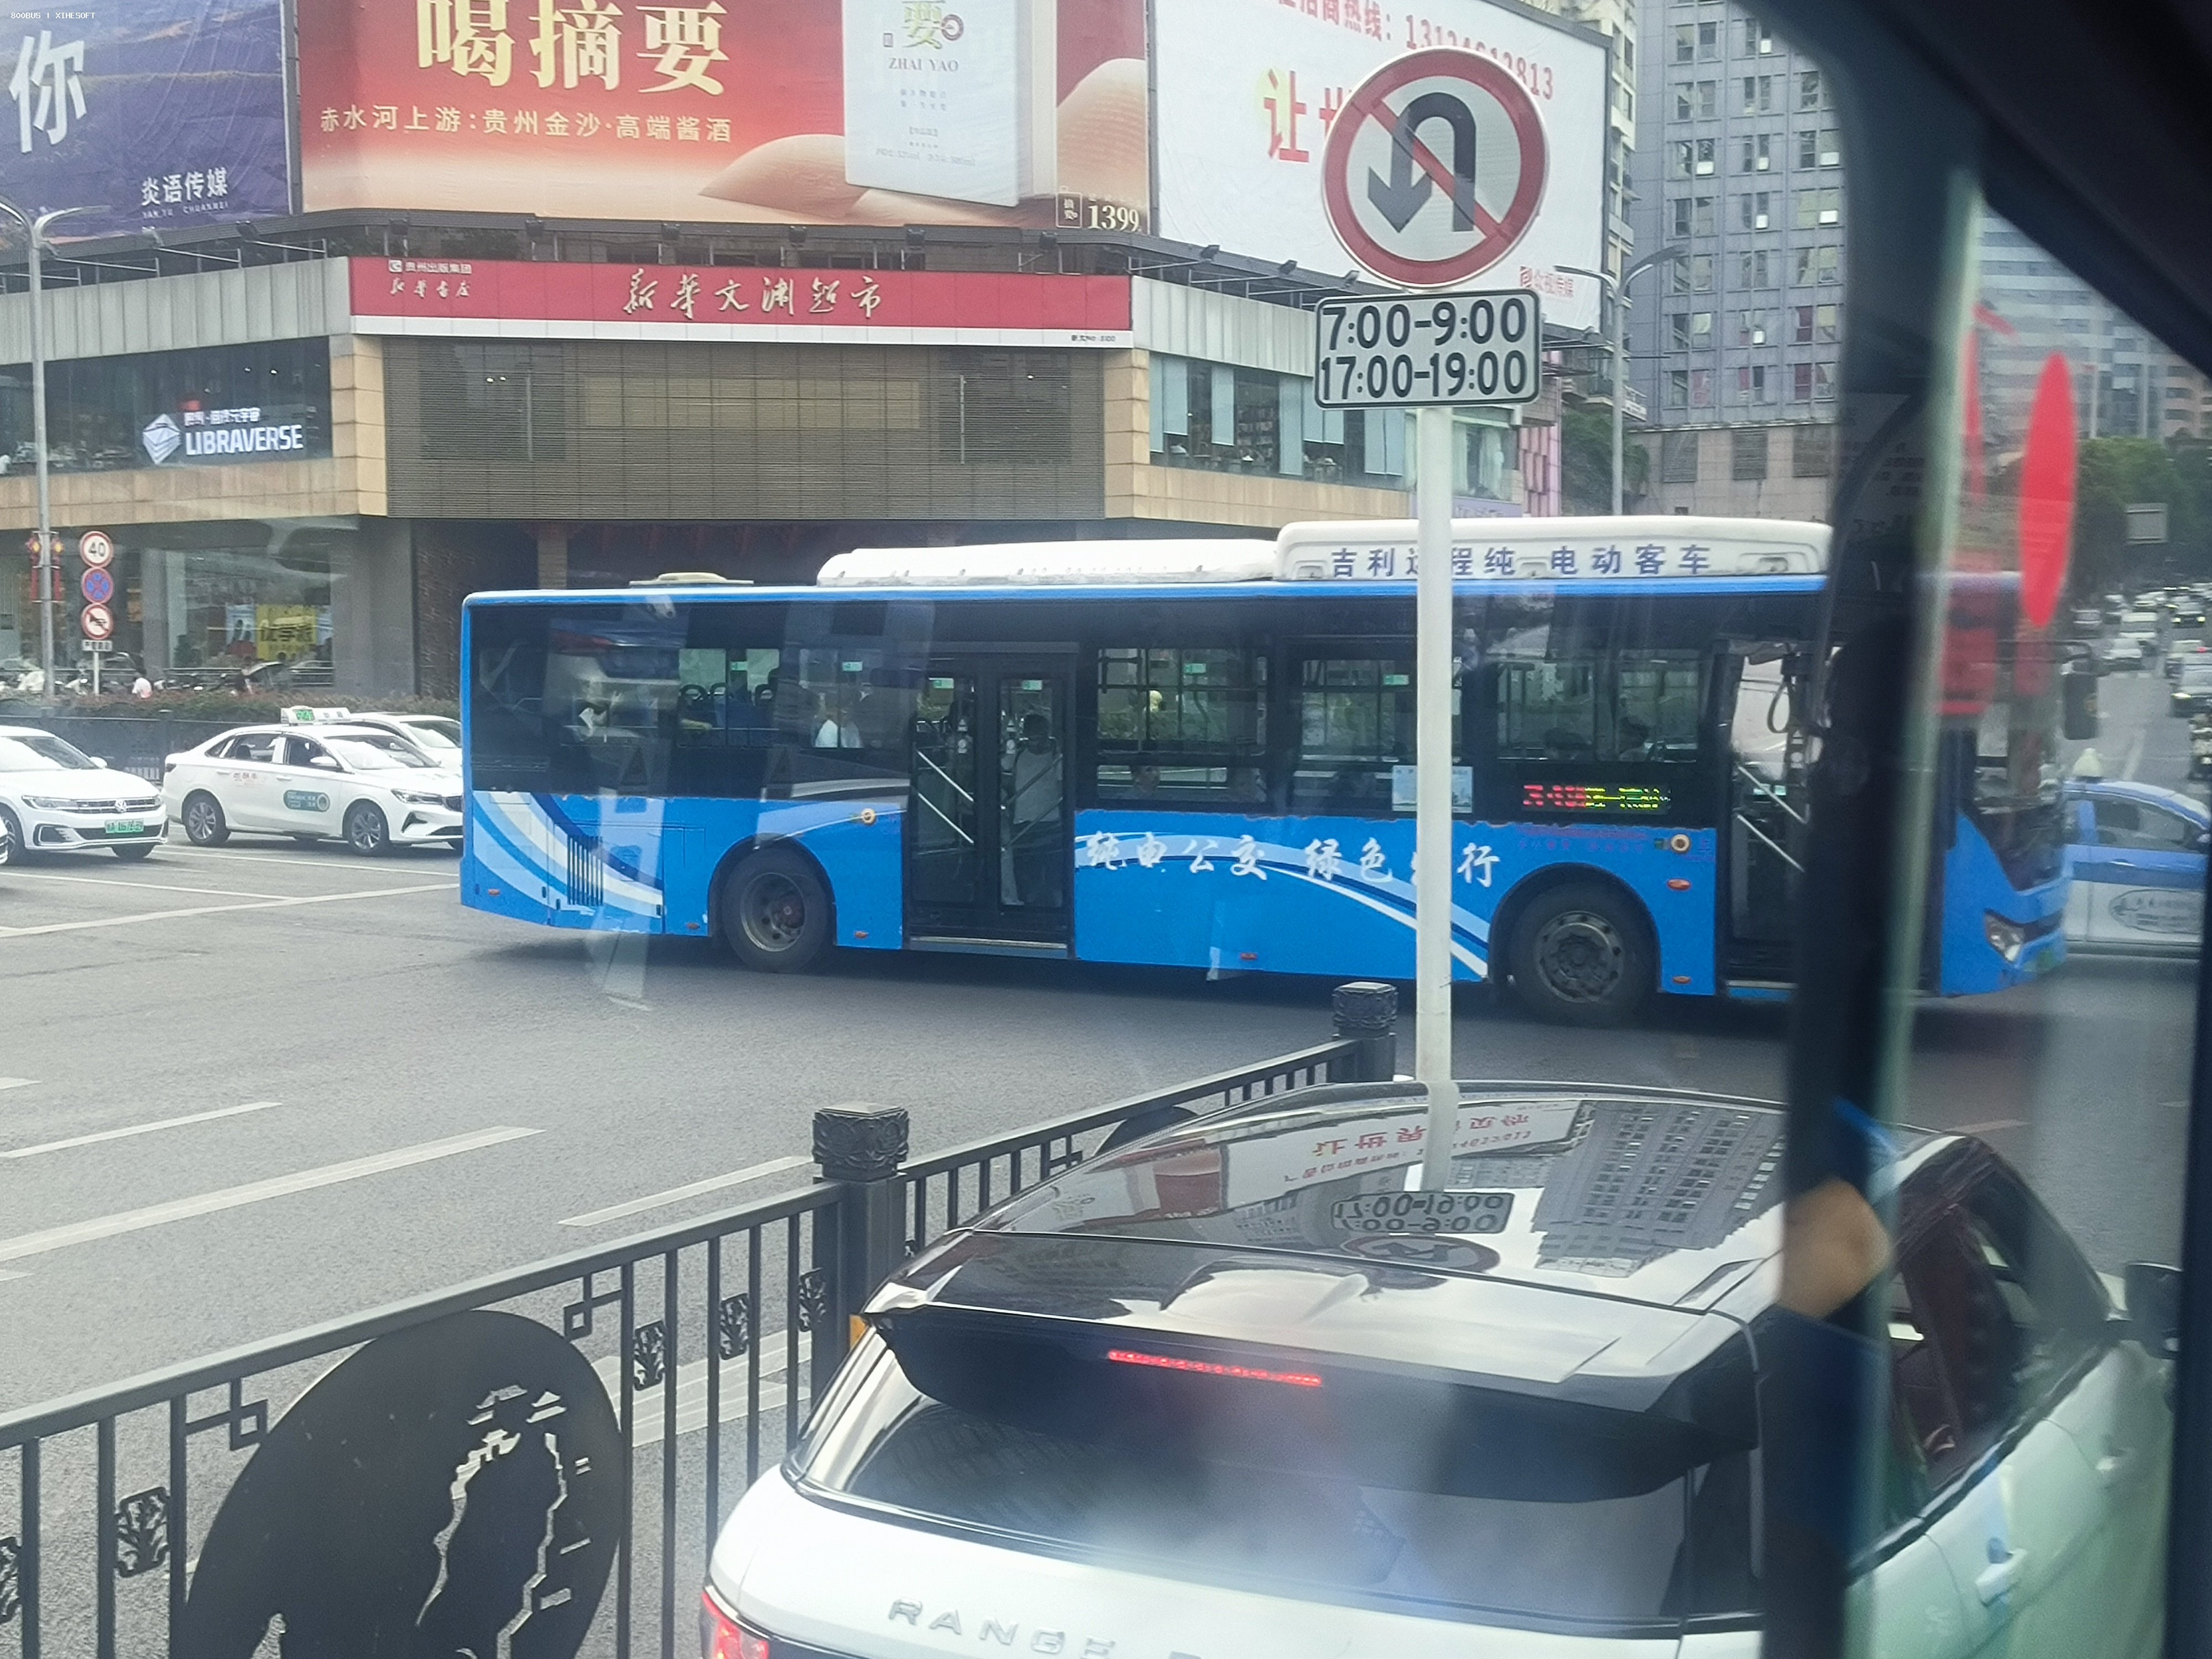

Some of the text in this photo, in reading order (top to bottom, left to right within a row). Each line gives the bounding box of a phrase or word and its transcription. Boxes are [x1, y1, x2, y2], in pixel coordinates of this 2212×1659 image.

[416, 0, 730, 96] 喝摘要
[889, 58, 959, 71] ZHAI YAO
[9, 30, 87, 154] 你
[141, 166, 228, 206] 炎语传媒
[1088, 205, 1140, 232] 1399
[1323, 298, 1527, 351] 7:00-9:00
[1321, 350, 1527, 400] 17:00-19:00
[186, 424, 304, 456] LIBRAVERSE
[88, 542, 106, 557] 40
[1305, 837, 1500, 887] 绿色行
[888, 1598, 1116, 1659] RANGE
